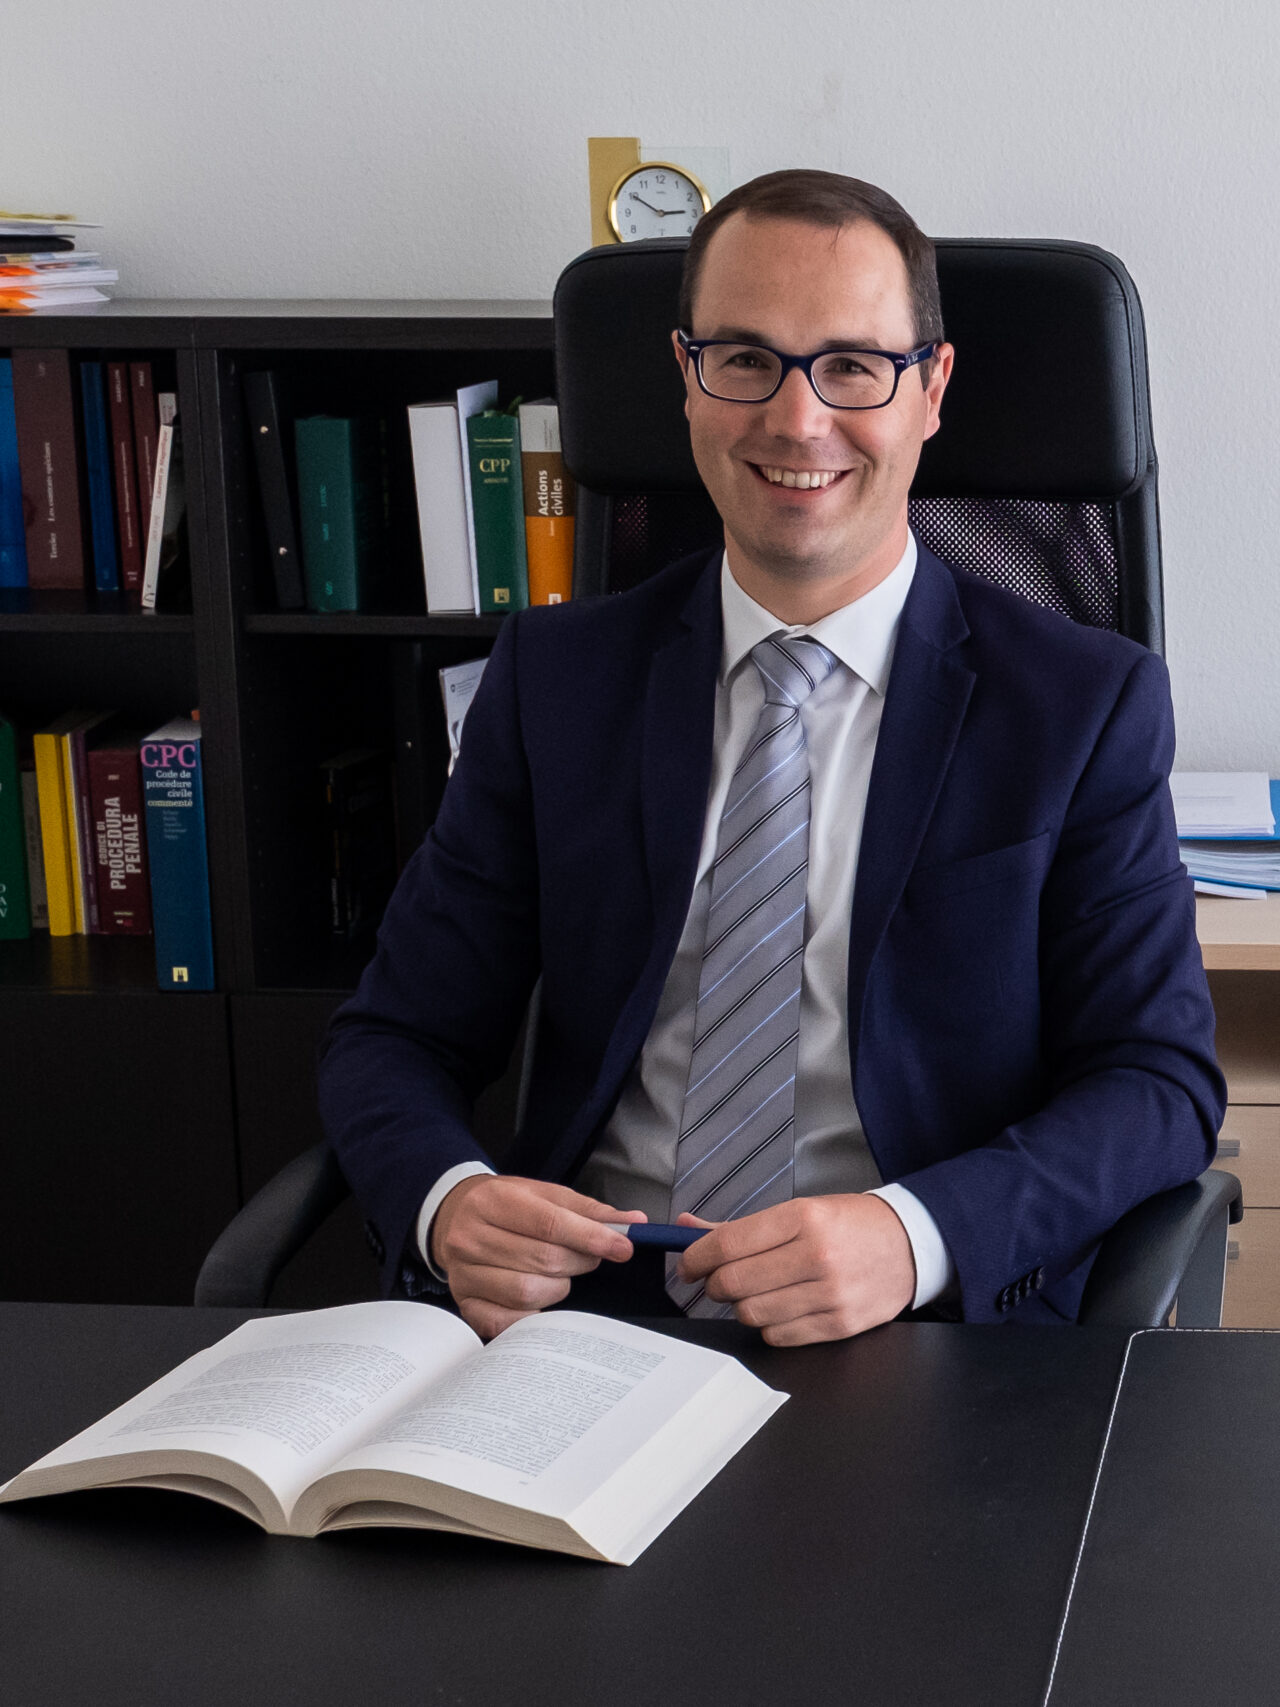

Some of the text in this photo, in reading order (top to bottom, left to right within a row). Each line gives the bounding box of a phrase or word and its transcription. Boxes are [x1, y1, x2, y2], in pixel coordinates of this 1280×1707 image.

[639, 180, 648, 189] 11
[655, 175, 666, 184] 12
[686, 192, 693, 202] 2
[625, 208, 631, 217] 9
[691, 209, 698, 219] 3
[630, 225, 637, 234] 8
[686, 225, 693, 233] 4
[479, 457, 511, 473] CPP
[538, 470, 549, 516] Actions
[551, 478, 563, 516] civiles
[140, 744, 197, 768] CPC
[155, 770, 192, 778] Code de
[146, 780, 192, 790] procédure
[167, 789, 193, 798] civile
[96, 821, 108, 865] CODICE DI
[104, 796, 127, 890] PROCEDURA
[122, 813, 142, 874] PENALE
